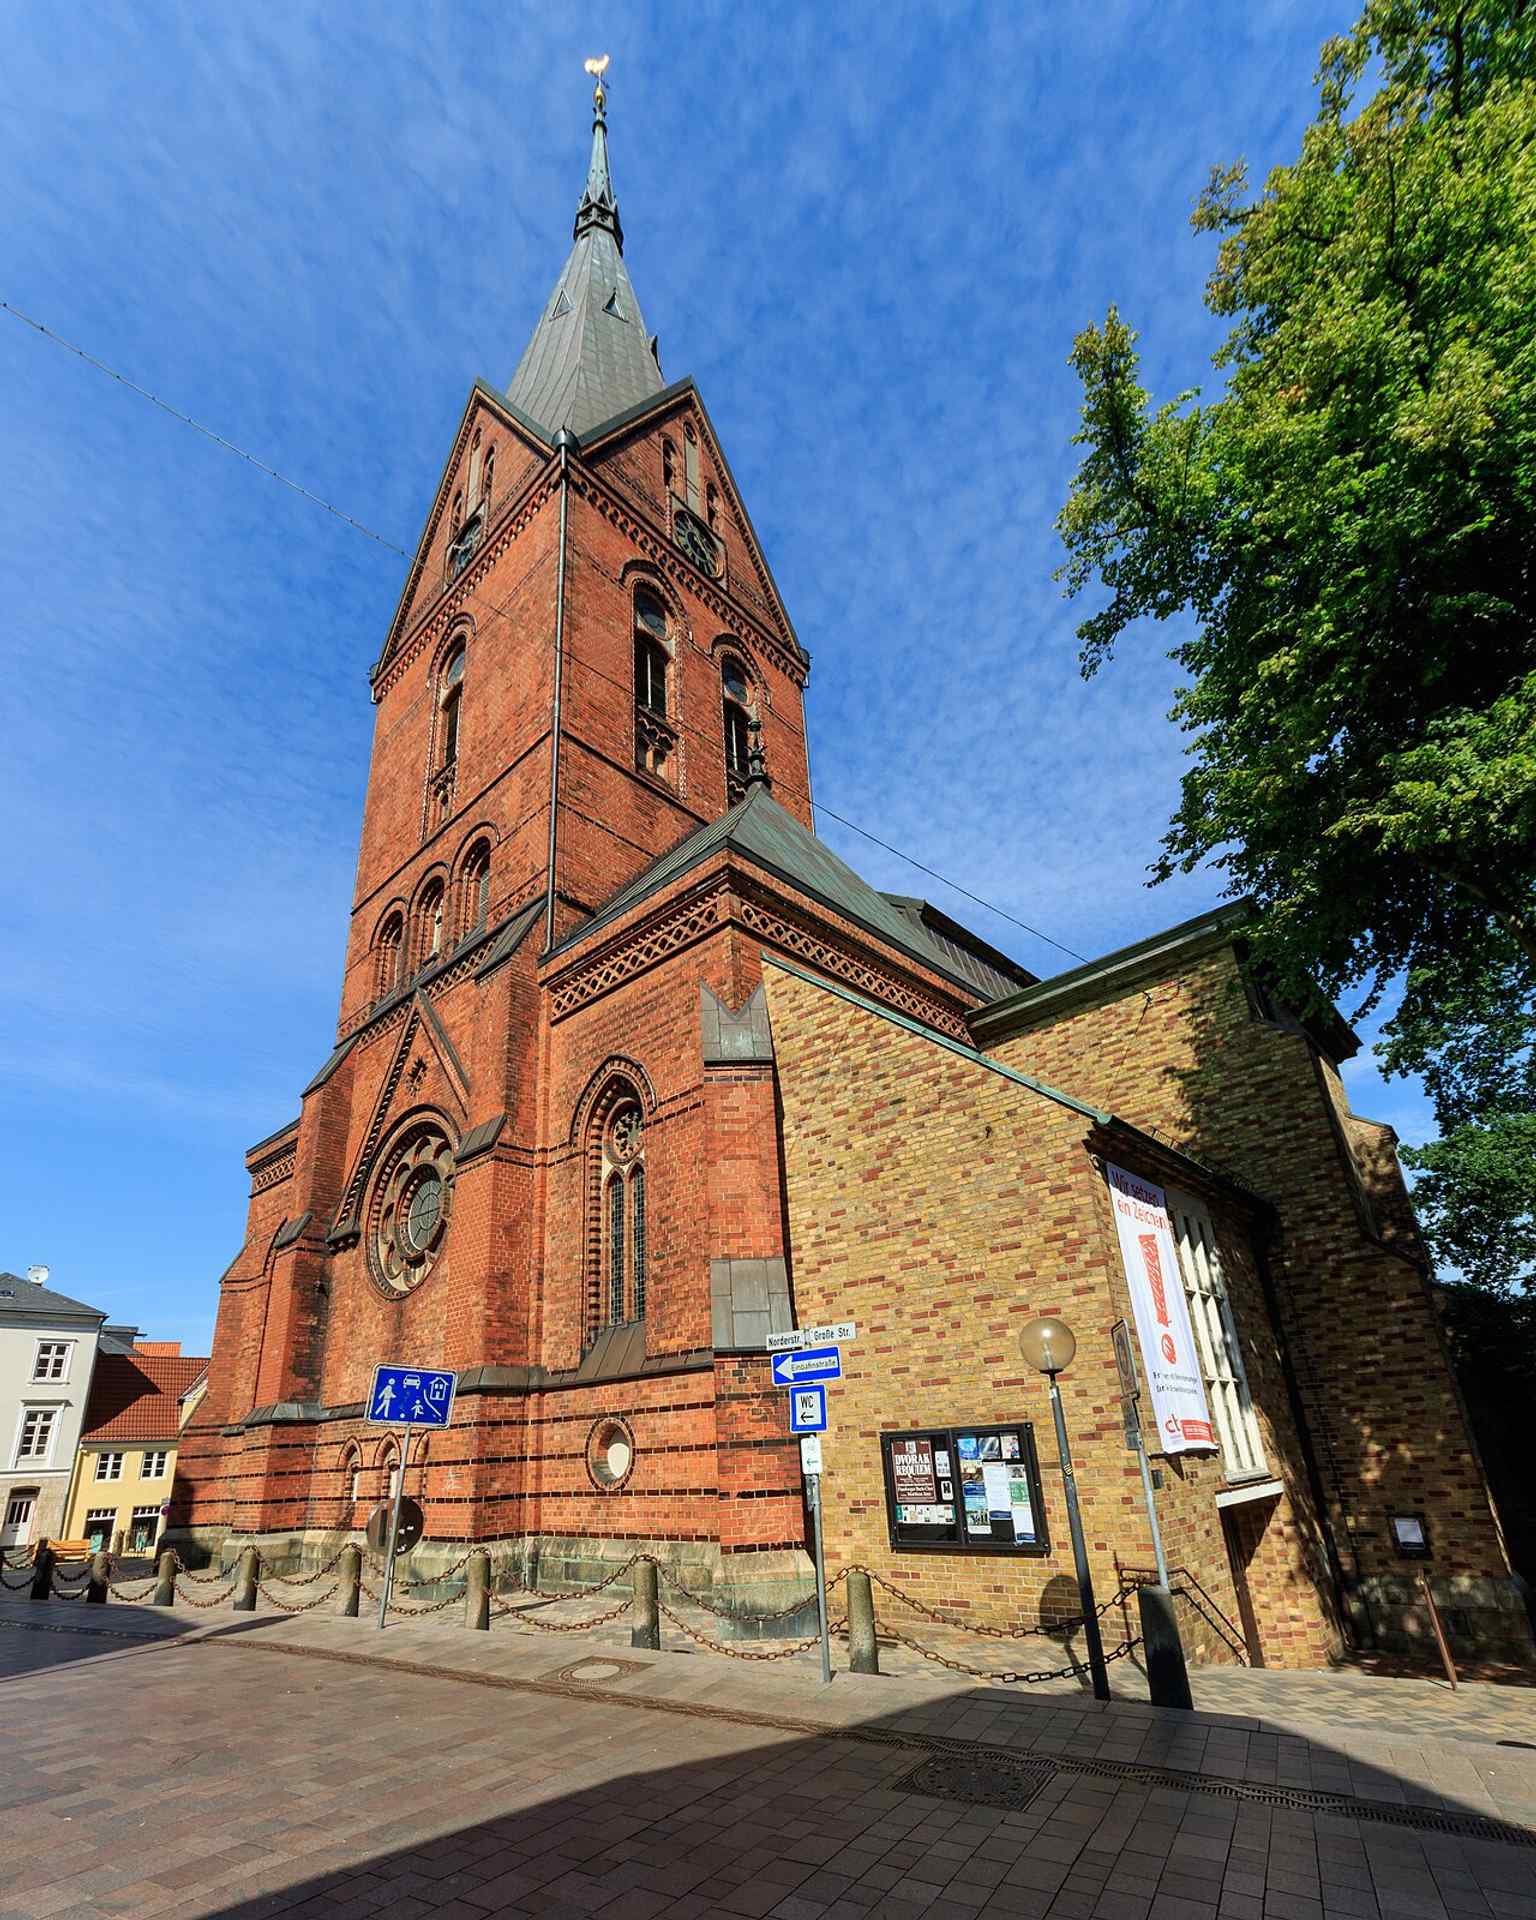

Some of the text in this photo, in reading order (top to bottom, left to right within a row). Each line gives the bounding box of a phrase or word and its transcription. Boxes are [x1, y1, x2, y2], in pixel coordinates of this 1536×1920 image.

[1118, 1199, 1131, 1217] ein
[767, 1335, 801, 1347] Norderstr.
[813, 1327, 851, 1341] Große Str.
[800, 1395, 814, 1409] WC
